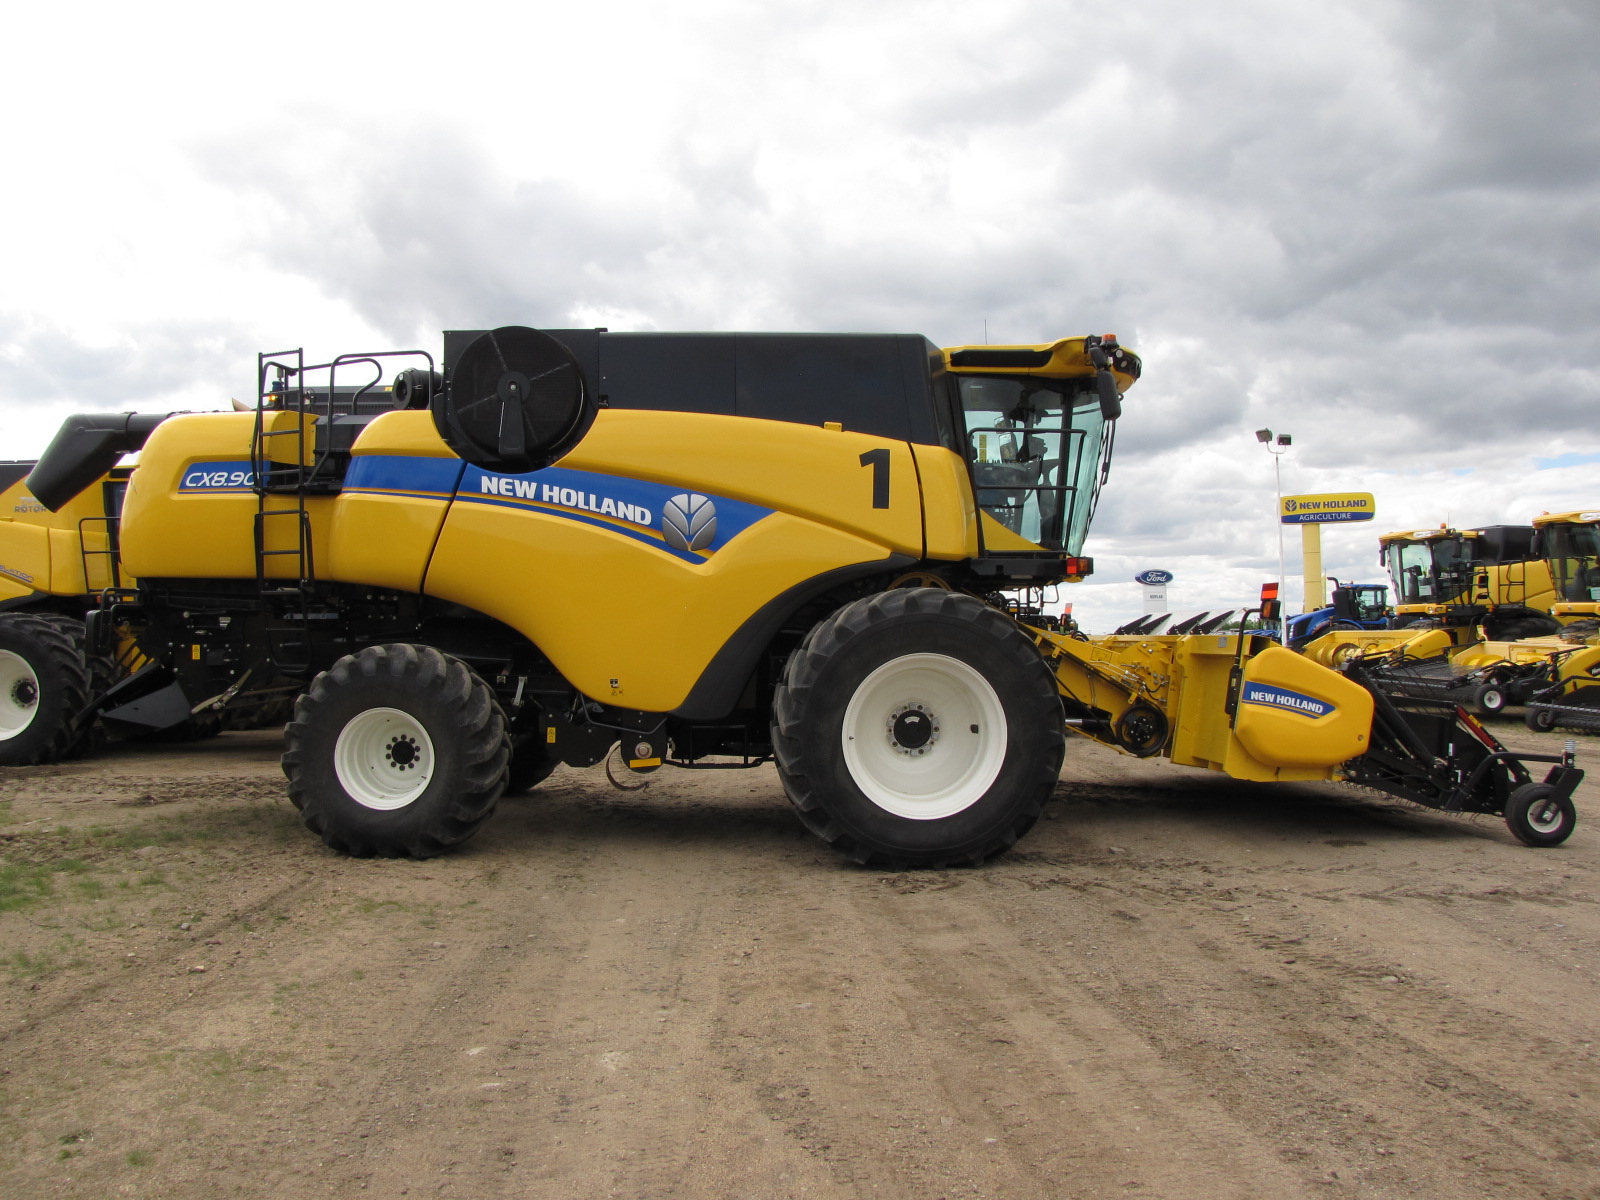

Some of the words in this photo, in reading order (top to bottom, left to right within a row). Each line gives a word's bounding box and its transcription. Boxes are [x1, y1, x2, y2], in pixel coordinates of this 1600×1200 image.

[185, 471, 260, 487] CX8.90
[859, 448, 890, 509] 1
[481, 475, 538, 500] NEW
[542, 484, 652, 526] HOLLAND
[1299, 501, 1321, 510] NEW
[1323, 499, 1367, 509] HOLLAND
[1299, 512, 1352, 521] AGRICULTURE
[1146, 571, 1167, 582] Ford
[1250, 691, 1275, 703] NEW
[1276, 694, 1324, 714] HOLLAND
